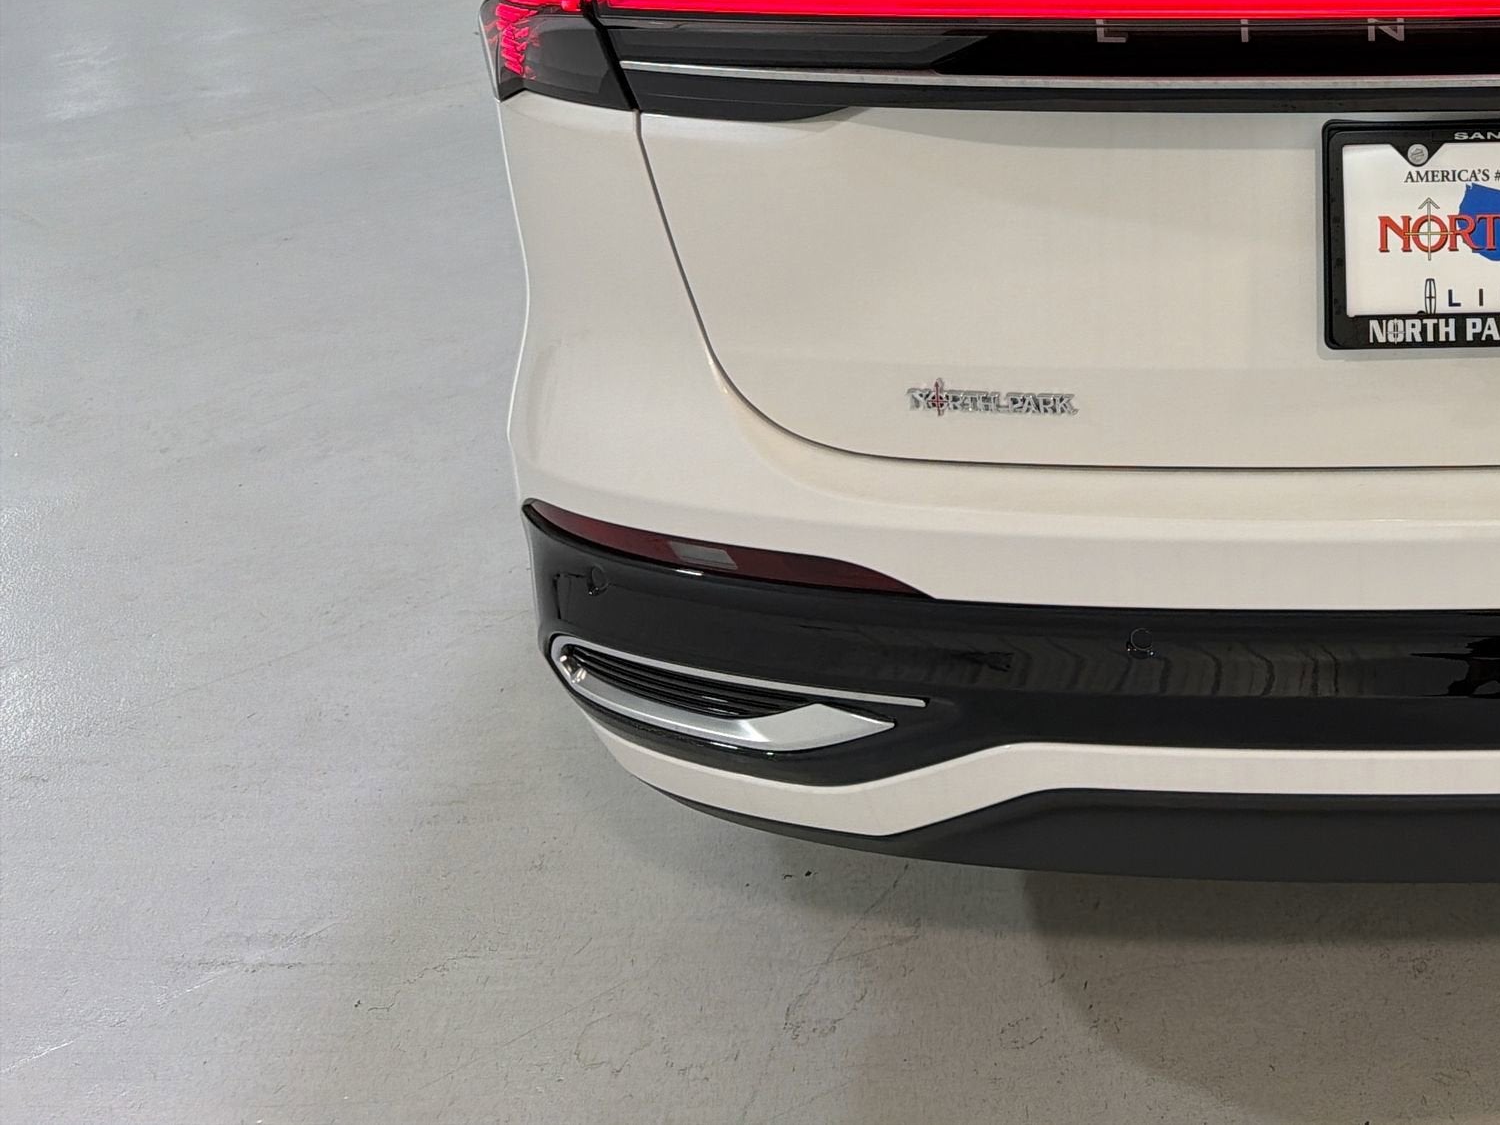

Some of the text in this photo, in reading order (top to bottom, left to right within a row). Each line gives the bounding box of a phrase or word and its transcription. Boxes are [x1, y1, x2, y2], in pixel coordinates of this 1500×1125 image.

[1404, 168, 1490, 183] AMERICA'S
[1368, 317, 1456, 344] NORTH
[1005, 393, 1080, 417] PARK
